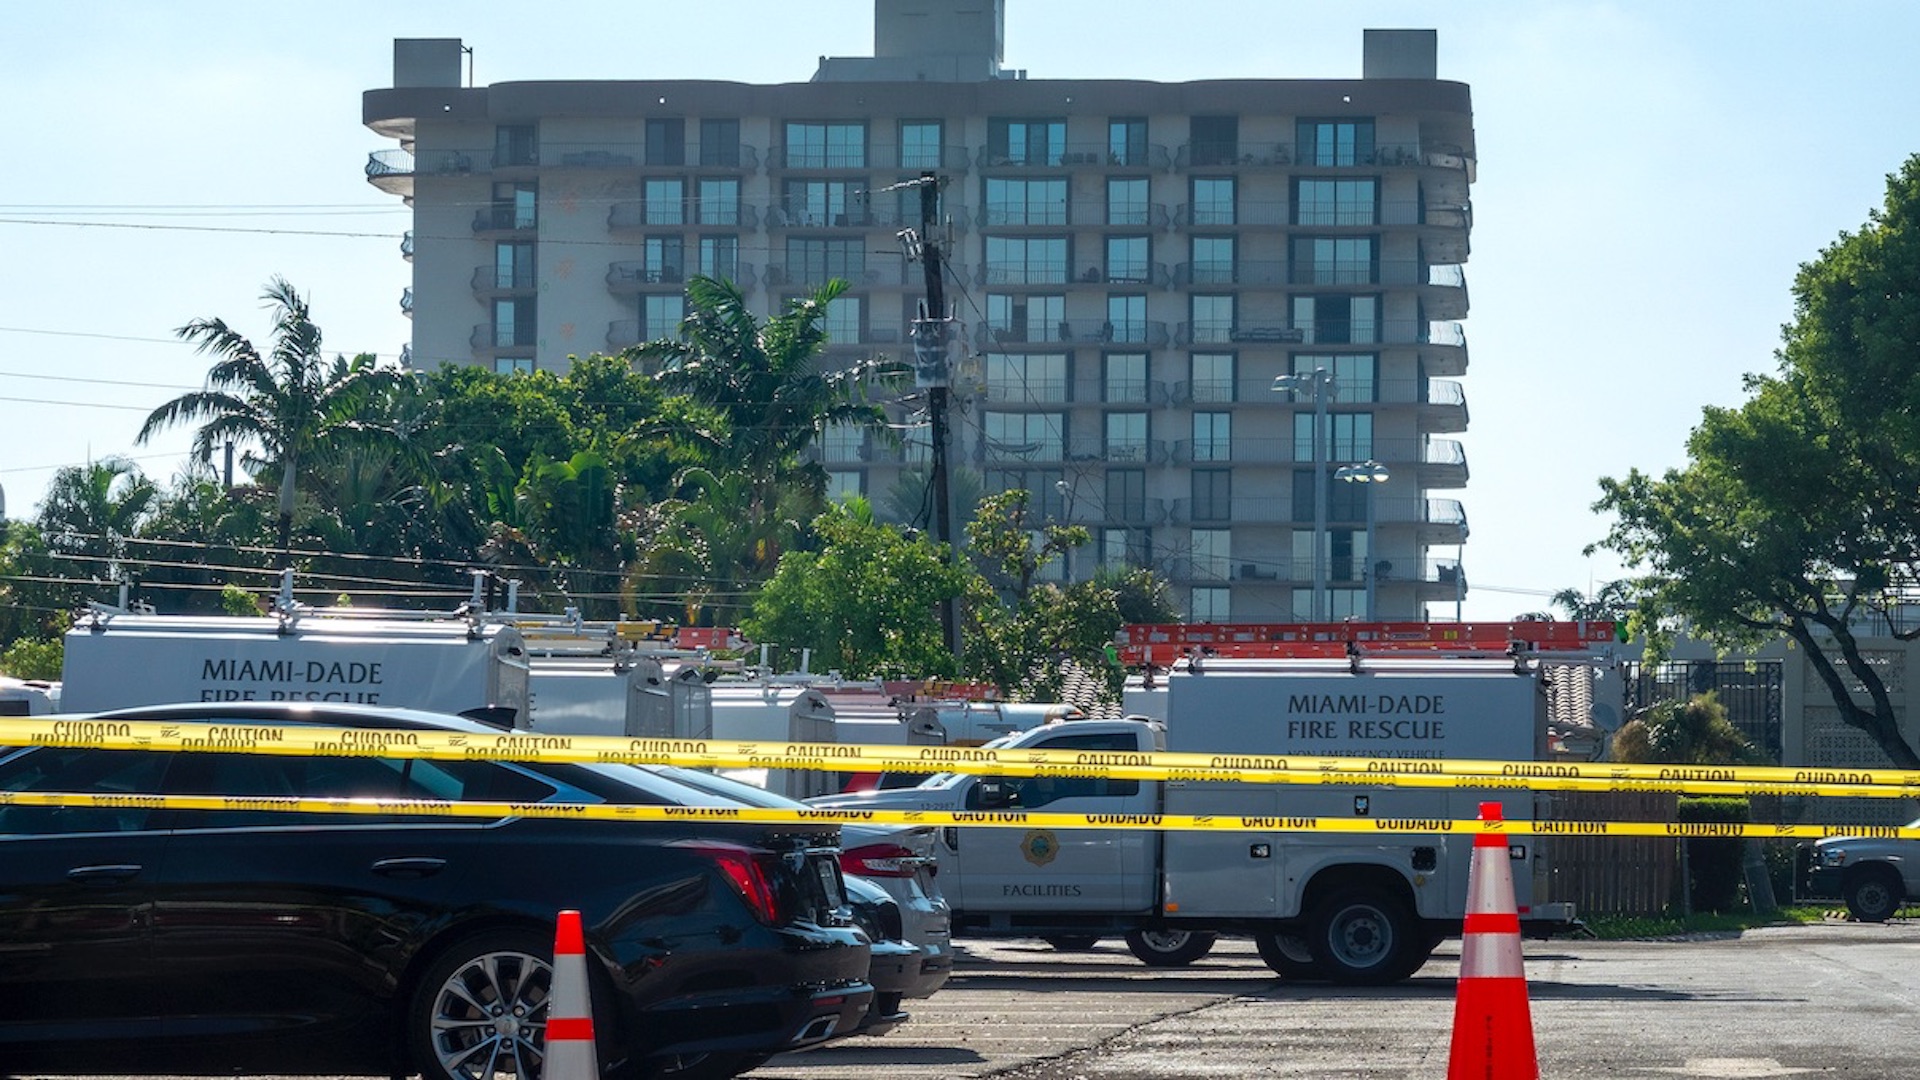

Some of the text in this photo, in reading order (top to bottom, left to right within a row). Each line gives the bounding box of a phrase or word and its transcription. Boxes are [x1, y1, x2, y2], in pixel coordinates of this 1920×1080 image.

[202, 659, 382, 684] MIAMI-DADE
[1288, 695, 1445, 714] MIAMI-DADE
[1288, 720, 1445, 740] FIRE RESCUE
[1532, 821, 1607, 833] CAUTION
[1666, 823, 1743, 836] CUIDADO
[1823, 826, 1898, 838] CAUTION
[1003, 885, 1082, 897] FACILITIES
